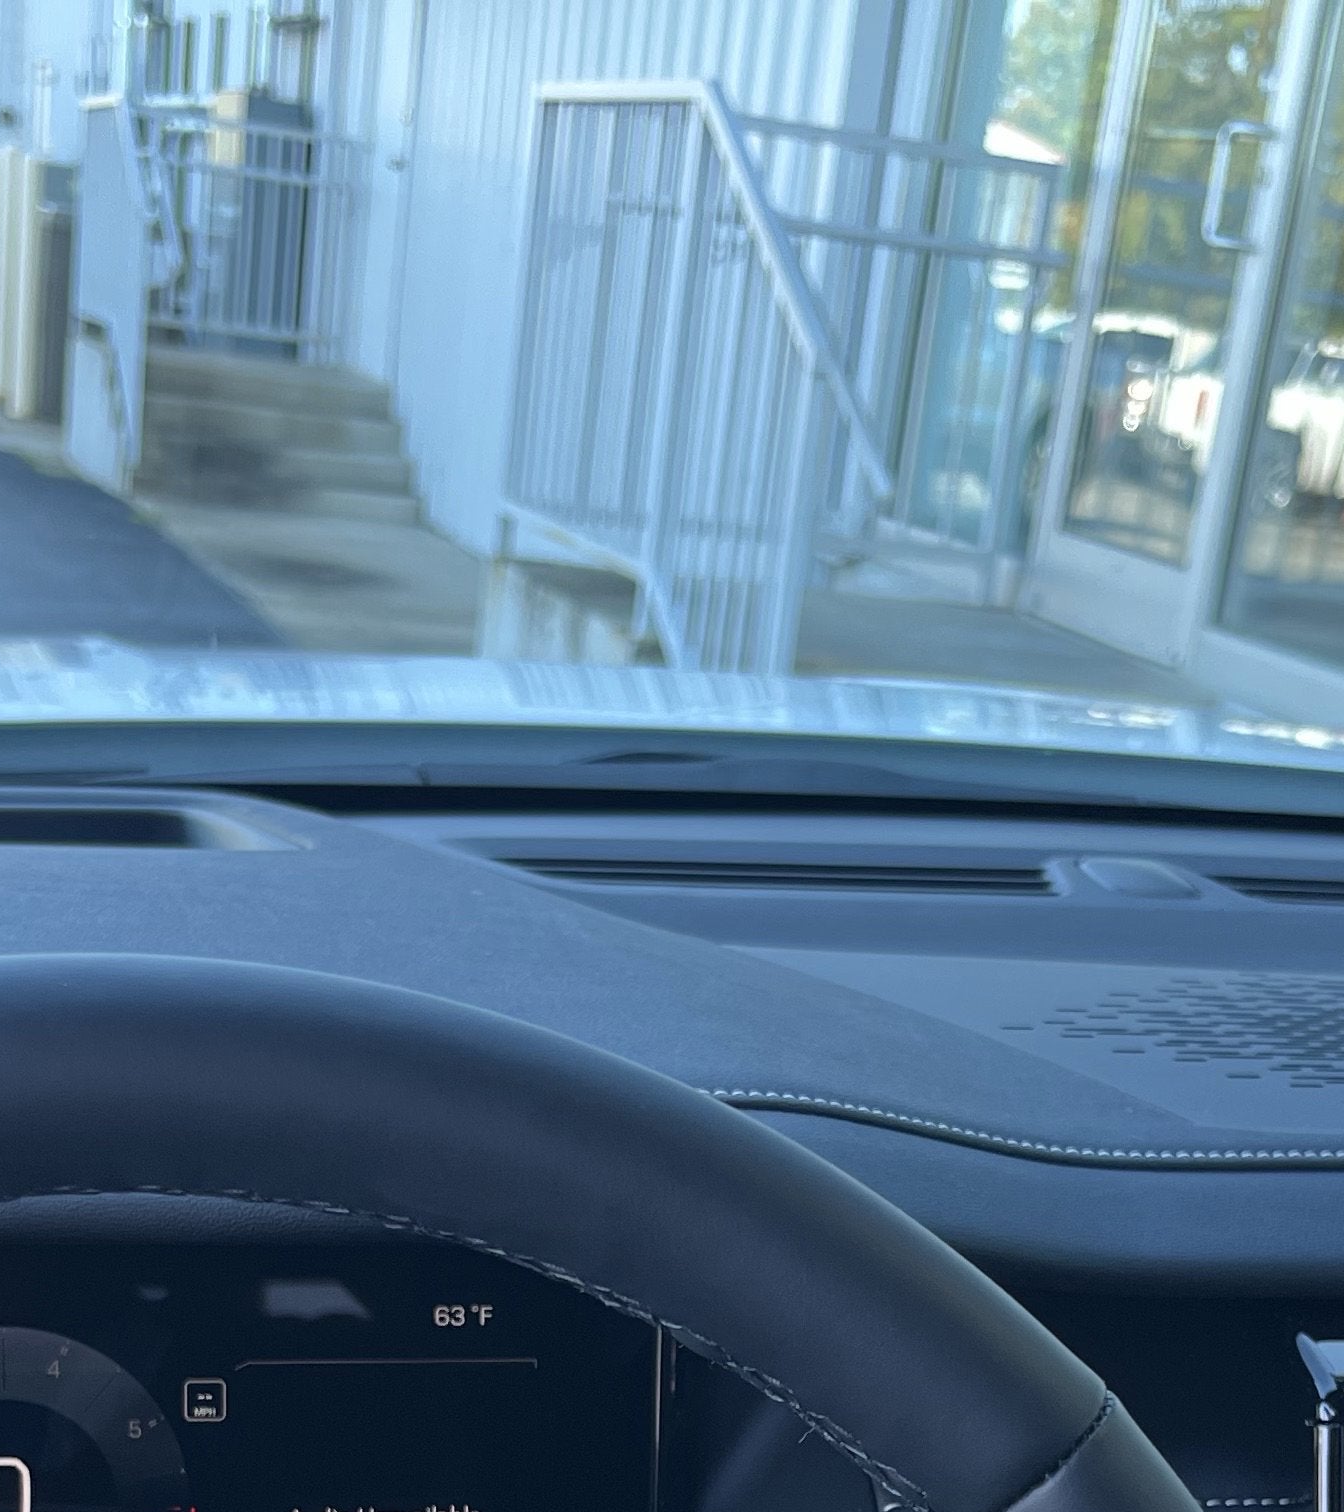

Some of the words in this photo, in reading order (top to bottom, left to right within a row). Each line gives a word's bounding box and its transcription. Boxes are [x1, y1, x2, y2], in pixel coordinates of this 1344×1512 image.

[433, 1306, 466, 1326] 63
[47, 1360, 61, 1378] 4
[128, 1421, 143, 1439] 5
